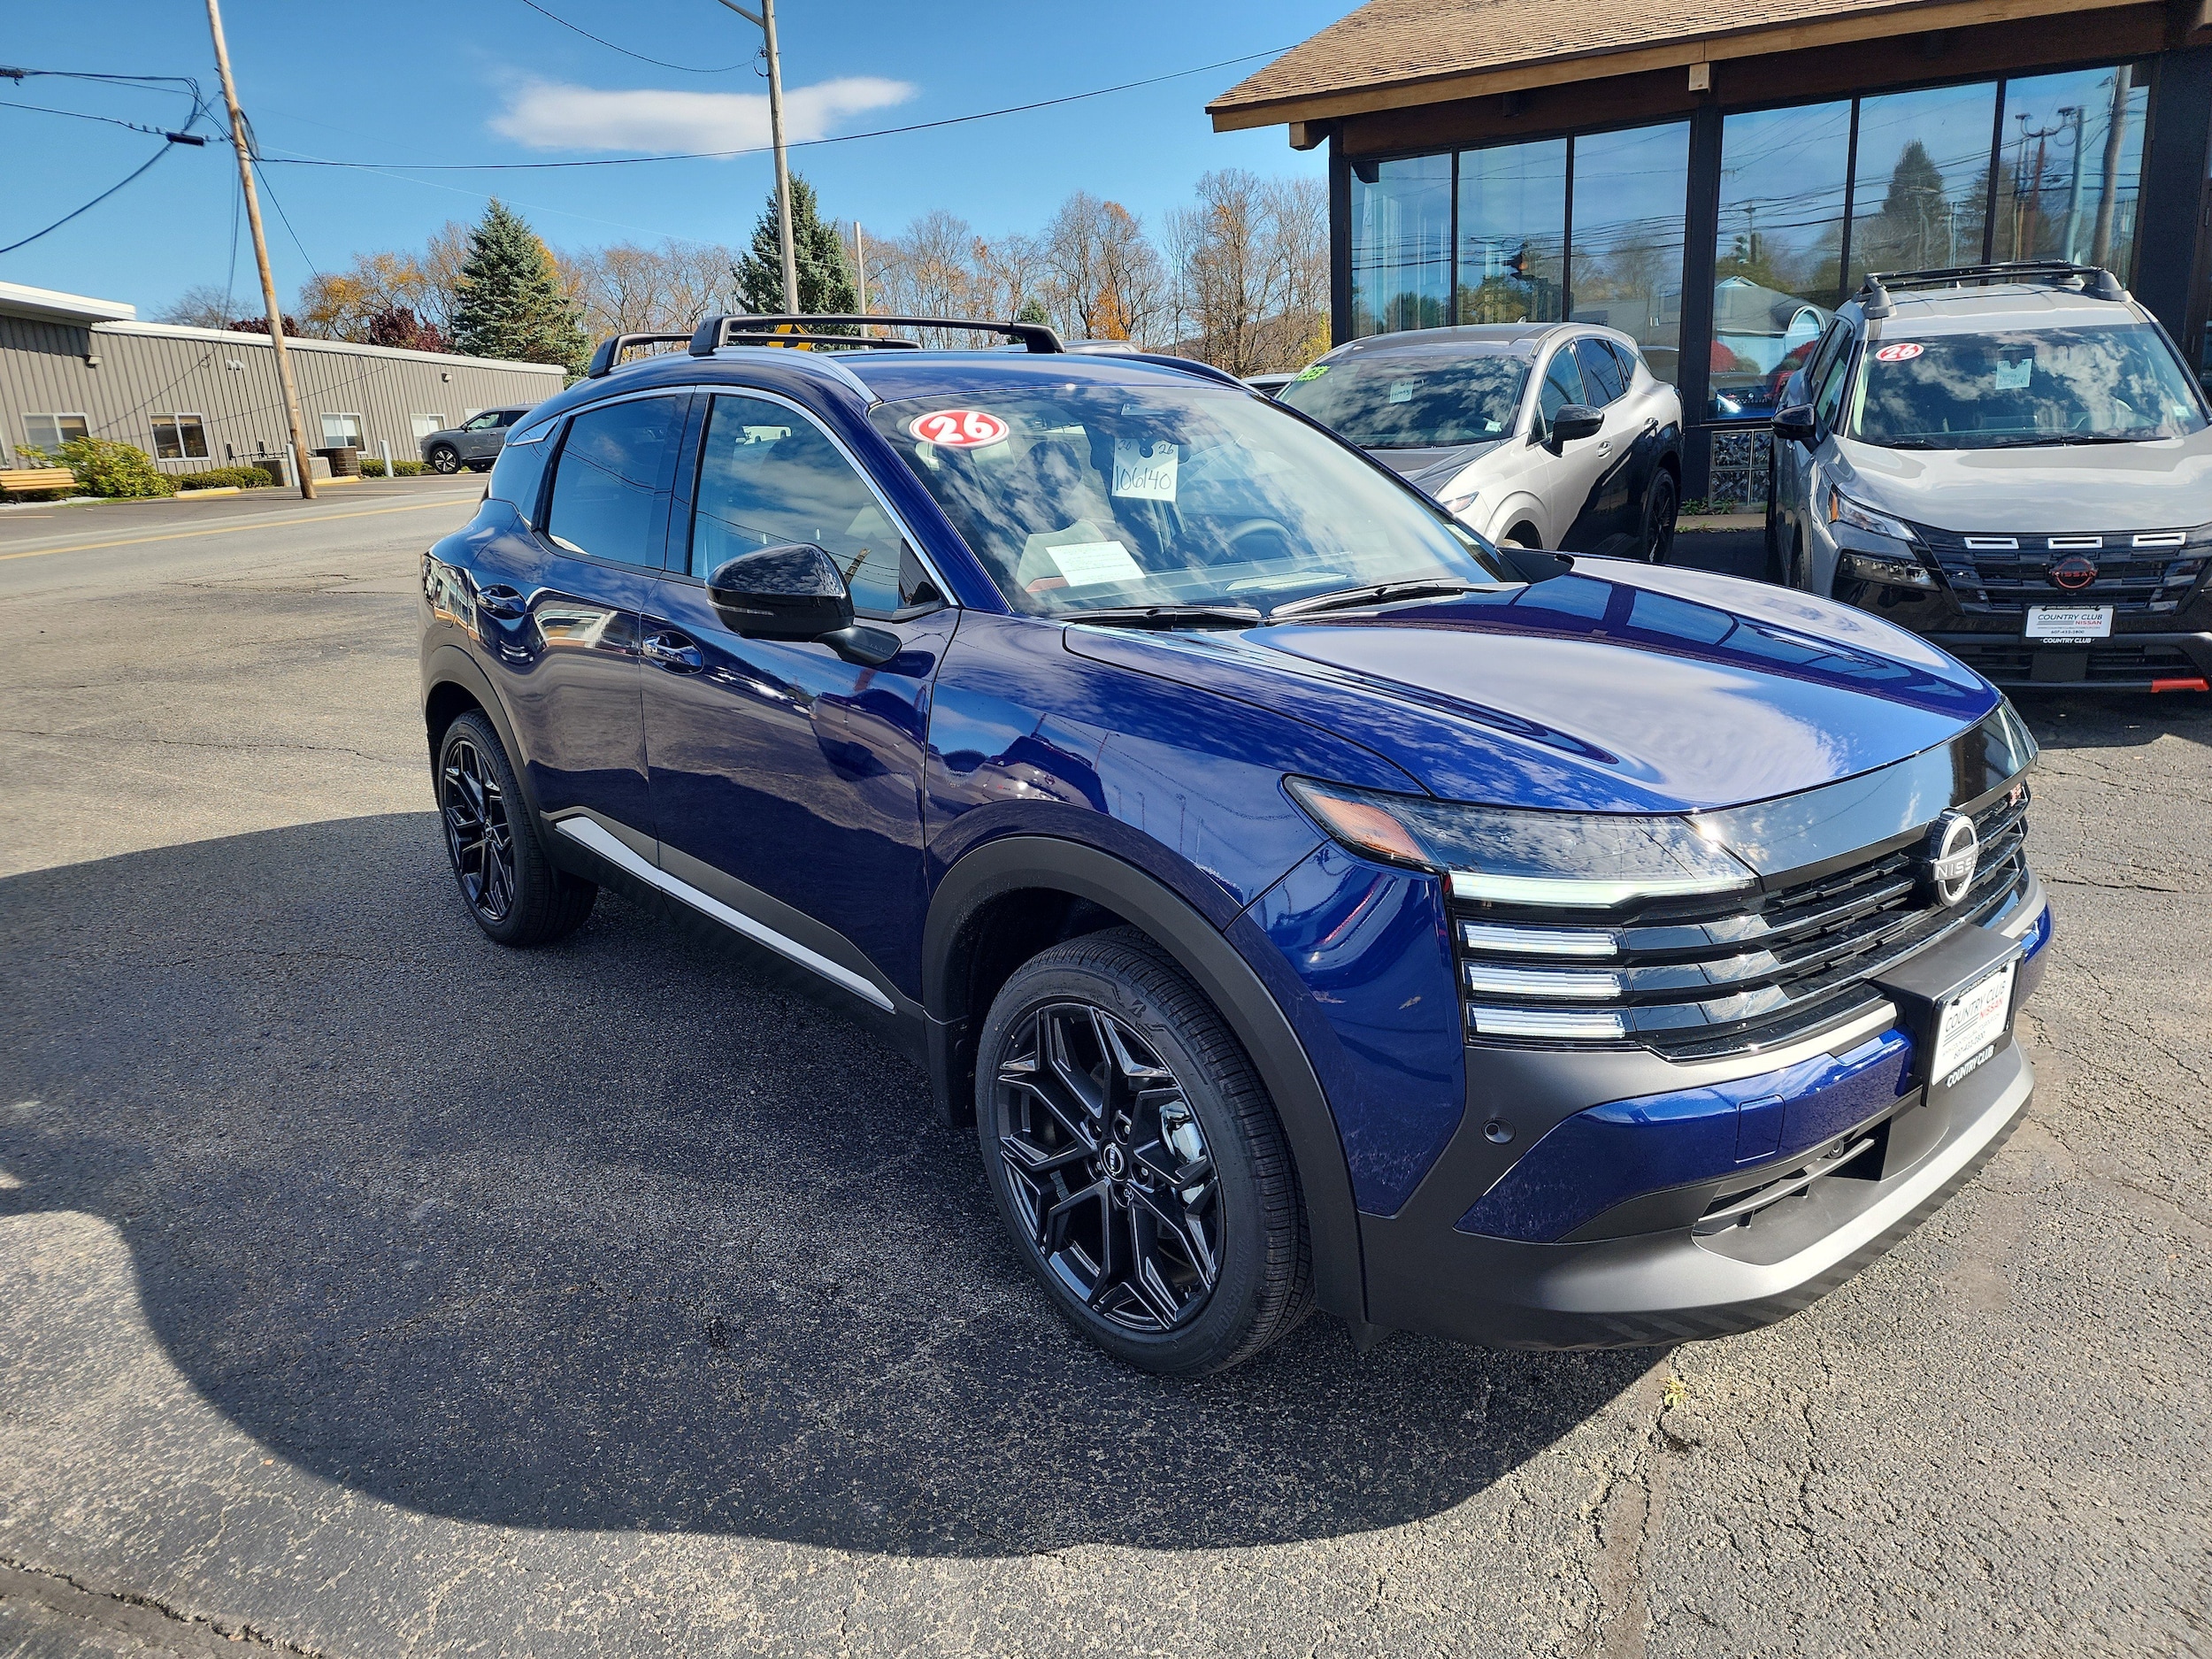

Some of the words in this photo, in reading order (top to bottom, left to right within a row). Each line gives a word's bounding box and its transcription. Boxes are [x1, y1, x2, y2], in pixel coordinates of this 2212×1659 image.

[1882, 344, 1916, 359] 26
[927, 412, 994, 442] 26
[1118, 439, 1132, 450] 20
[1158, 443, 1174, 455] 26
[1116, 465, 1171, 491] 106140
[1937, 854, 1977, 879] NISS
[1945, 993, 1986, 1033] COUNTRY
[1986, 980, 2006, 1004] CLUB
[1979, 997, 2004, 1020] NISSAN
[1947, 1057, 1978, 1088] COUNTRY
[1977, 1044, 1994, 1068] CLUB
